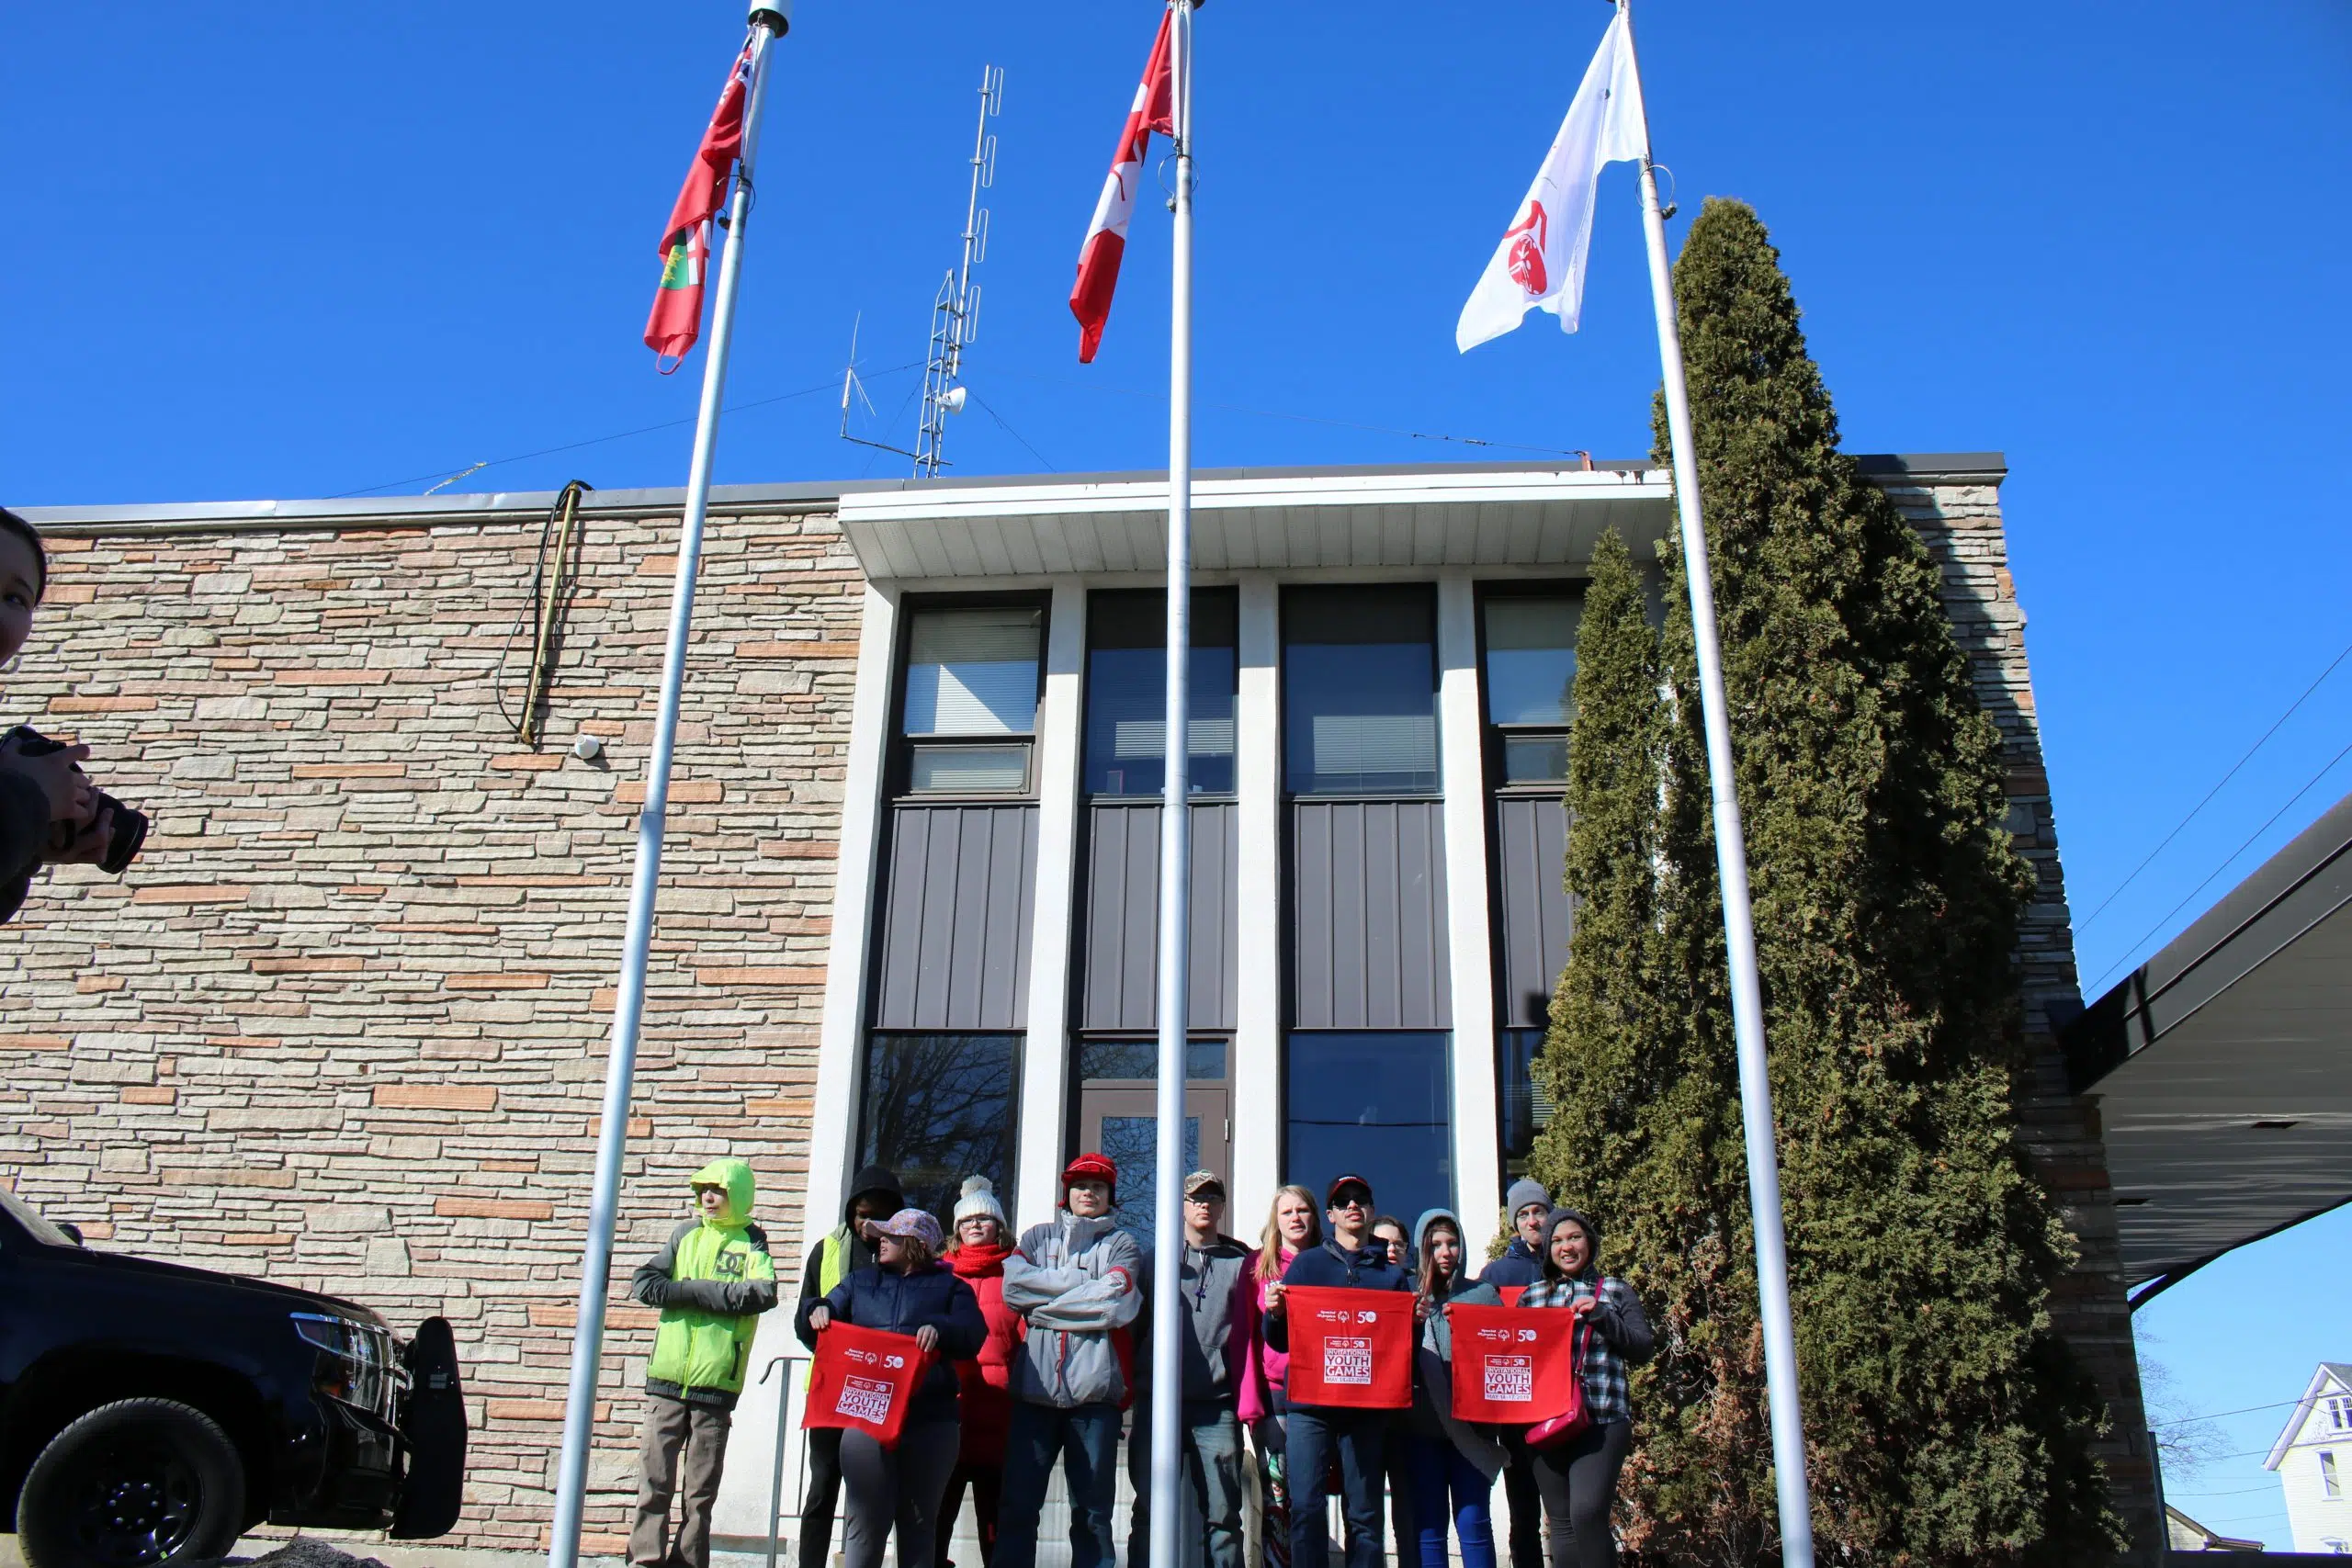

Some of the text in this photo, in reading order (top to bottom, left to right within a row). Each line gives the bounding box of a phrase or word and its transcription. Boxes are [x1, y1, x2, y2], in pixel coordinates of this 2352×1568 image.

[1357, 1311, 1376, 1324] 50
[1517, 1329, 1537, 1342] 50
[1352, 1340, 1365, 1348] 50
[883, 1355, 904, 1369] 50
[1327, 1356, 1369, 1366] YOUTH
[1327, 1366, 1369, 1377] GAMES
[1487, 1373, 1530, 1383] YOUTH
[874, 1383, 887, 1392] 50
[1487, 1384, 1530, 1394] GAMES
[845, 1387, 889, 1401] INVITATIONAL
[844, 1393, 887, 1409] YOUTH
[840, 1401, 884, 1419] GAMES
